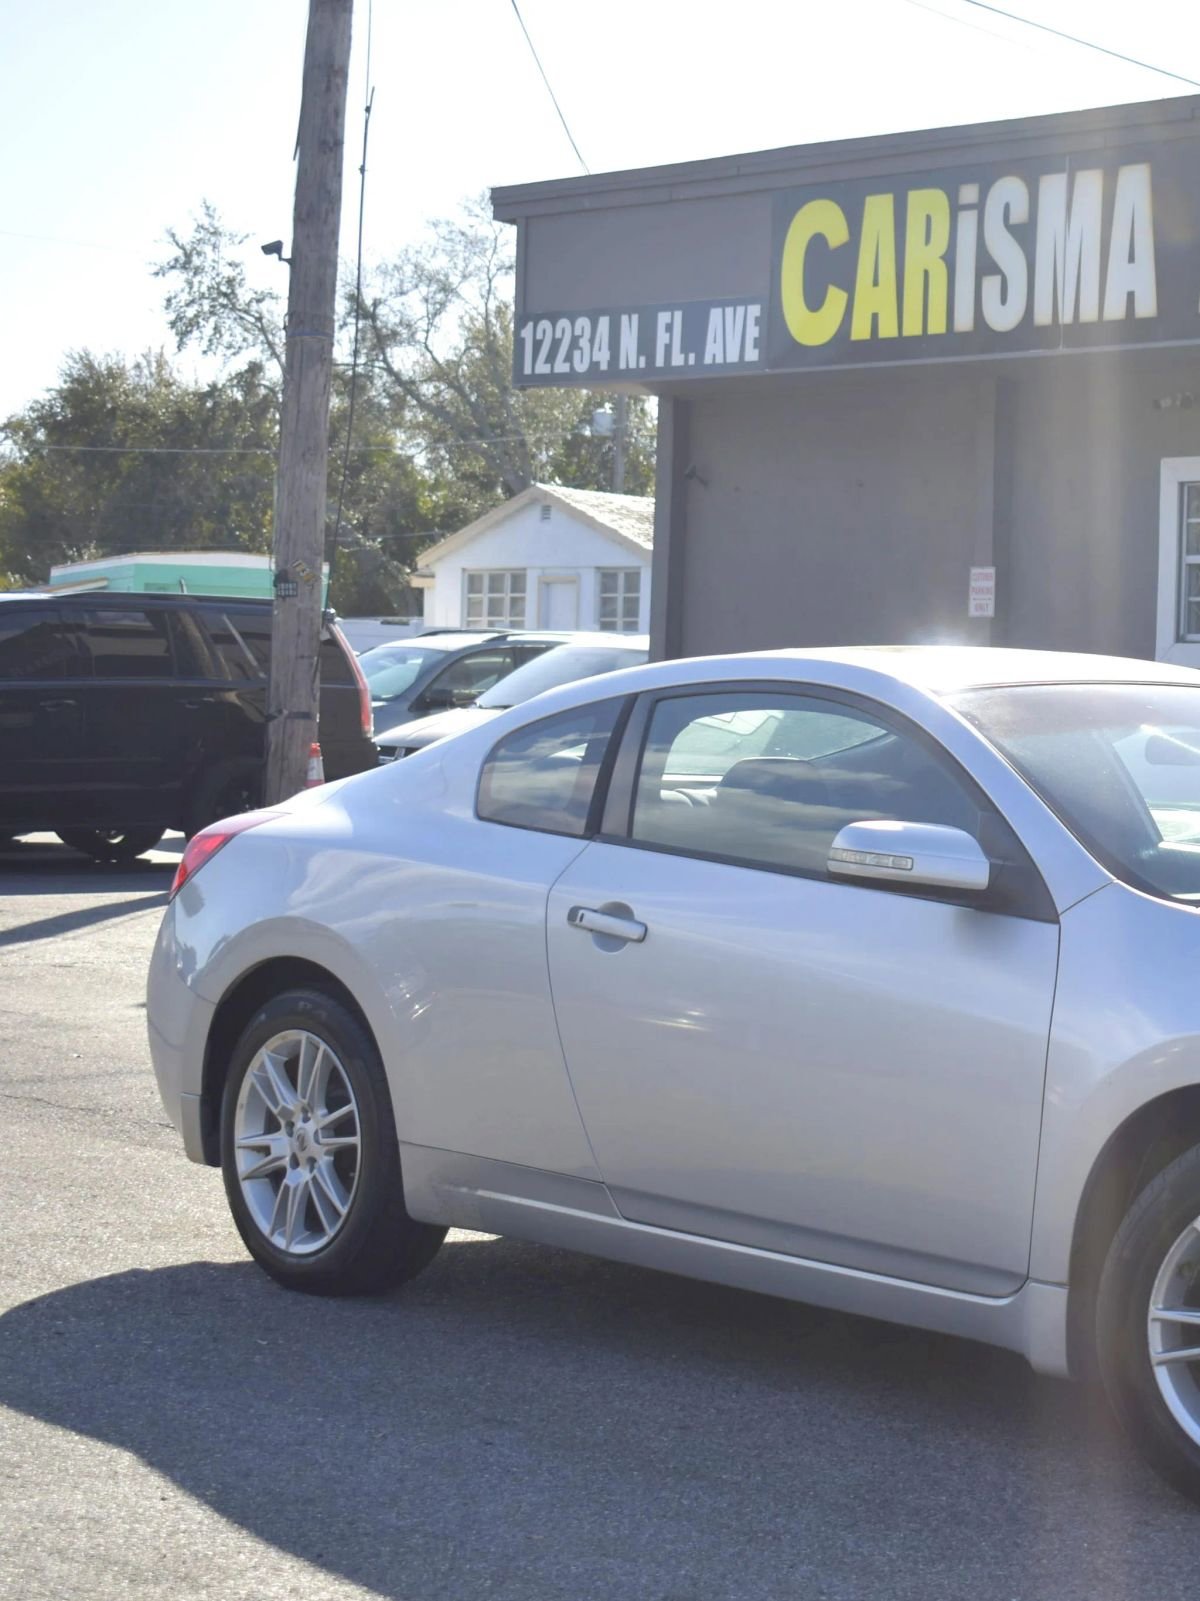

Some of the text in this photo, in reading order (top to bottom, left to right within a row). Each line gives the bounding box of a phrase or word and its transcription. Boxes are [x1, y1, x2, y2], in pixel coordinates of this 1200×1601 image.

[781, 163, 1157, 346] CARiSMA
[520, 304, 762, 375] 12234 N. FL. AVE
